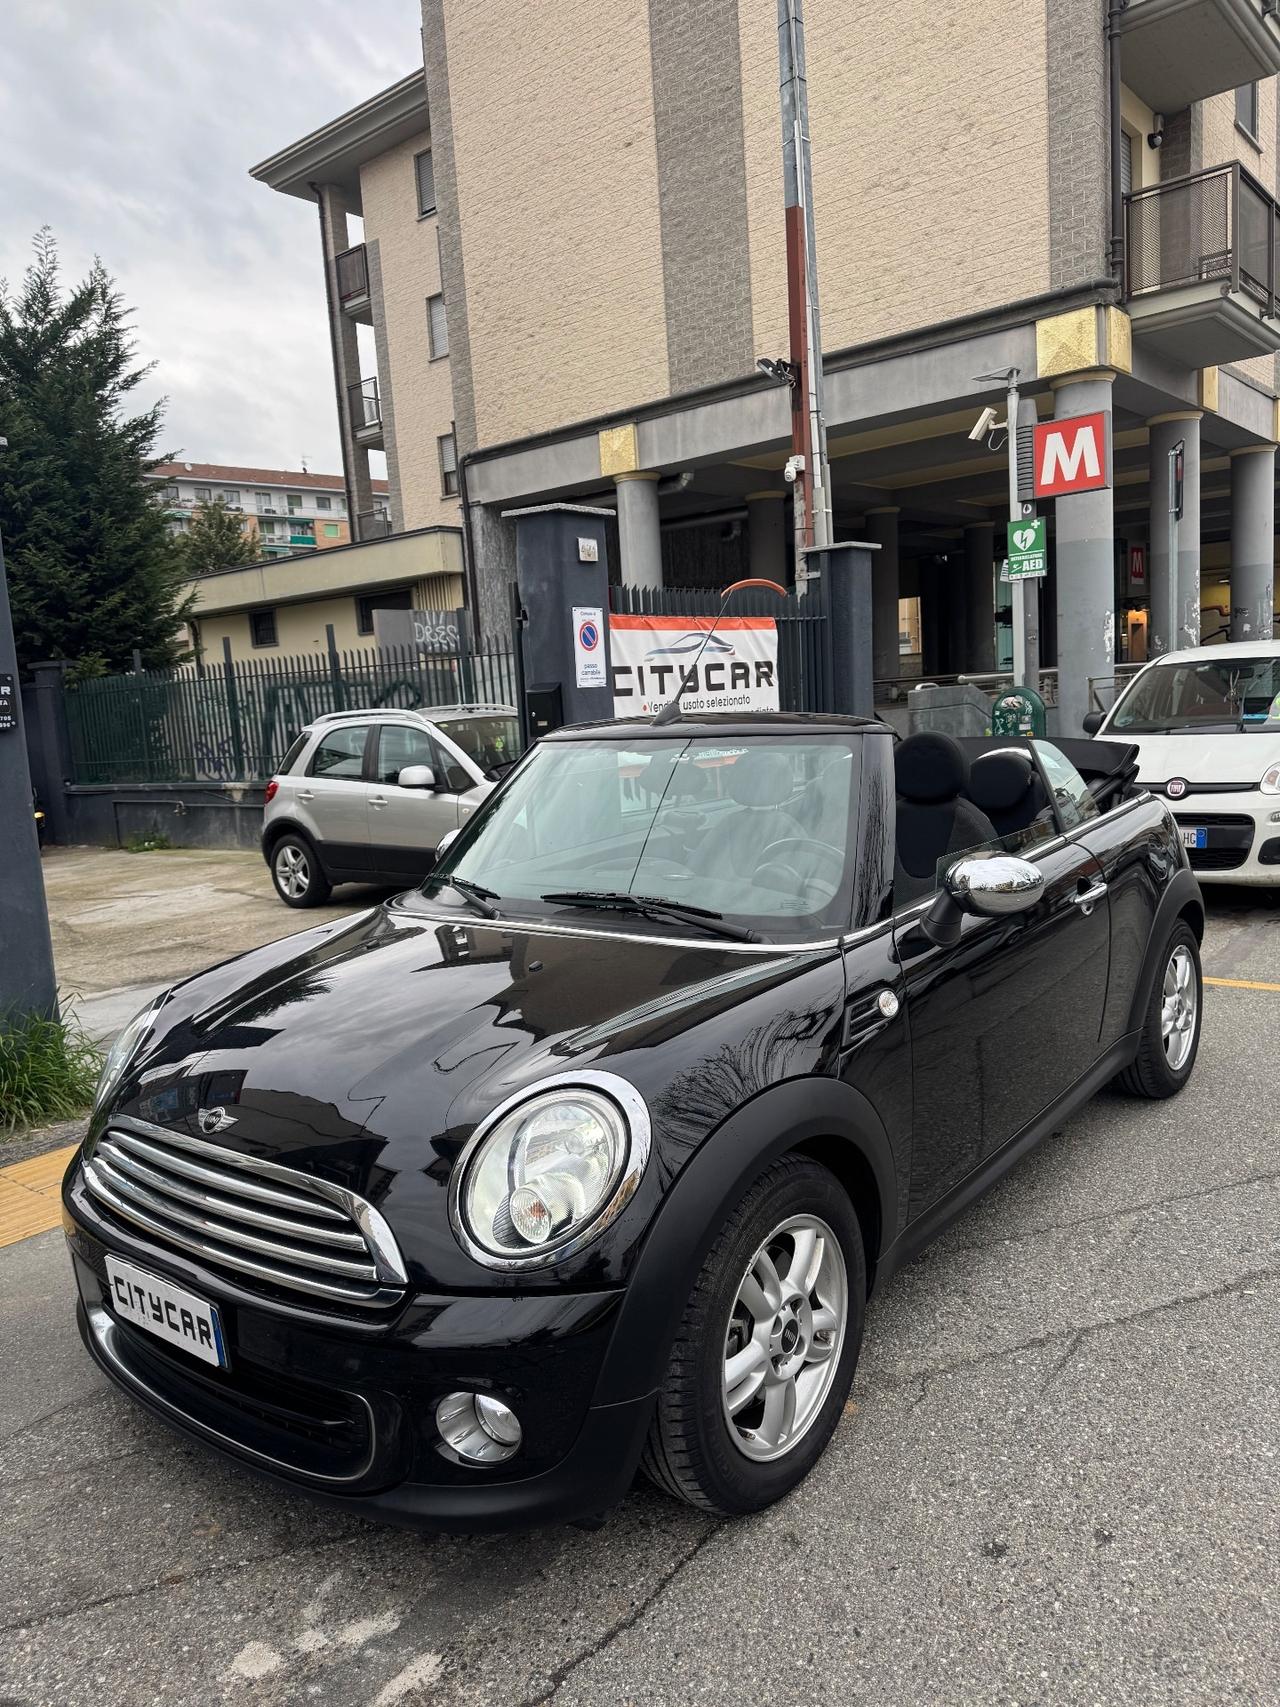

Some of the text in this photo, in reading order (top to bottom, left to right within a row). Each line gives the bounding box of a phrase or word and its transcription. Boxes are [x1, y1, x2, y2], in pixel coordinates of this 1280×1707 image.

[1041, 426, 1101, 485] M
[1022, 559, 1043, 571] AED
[612, 660, 774, 697] CITYCAR
[683, 699, 705, 711] usato
[706, 695, 751, 707] selezionato
[113, 1275, 213, 1350] CITYCAR
